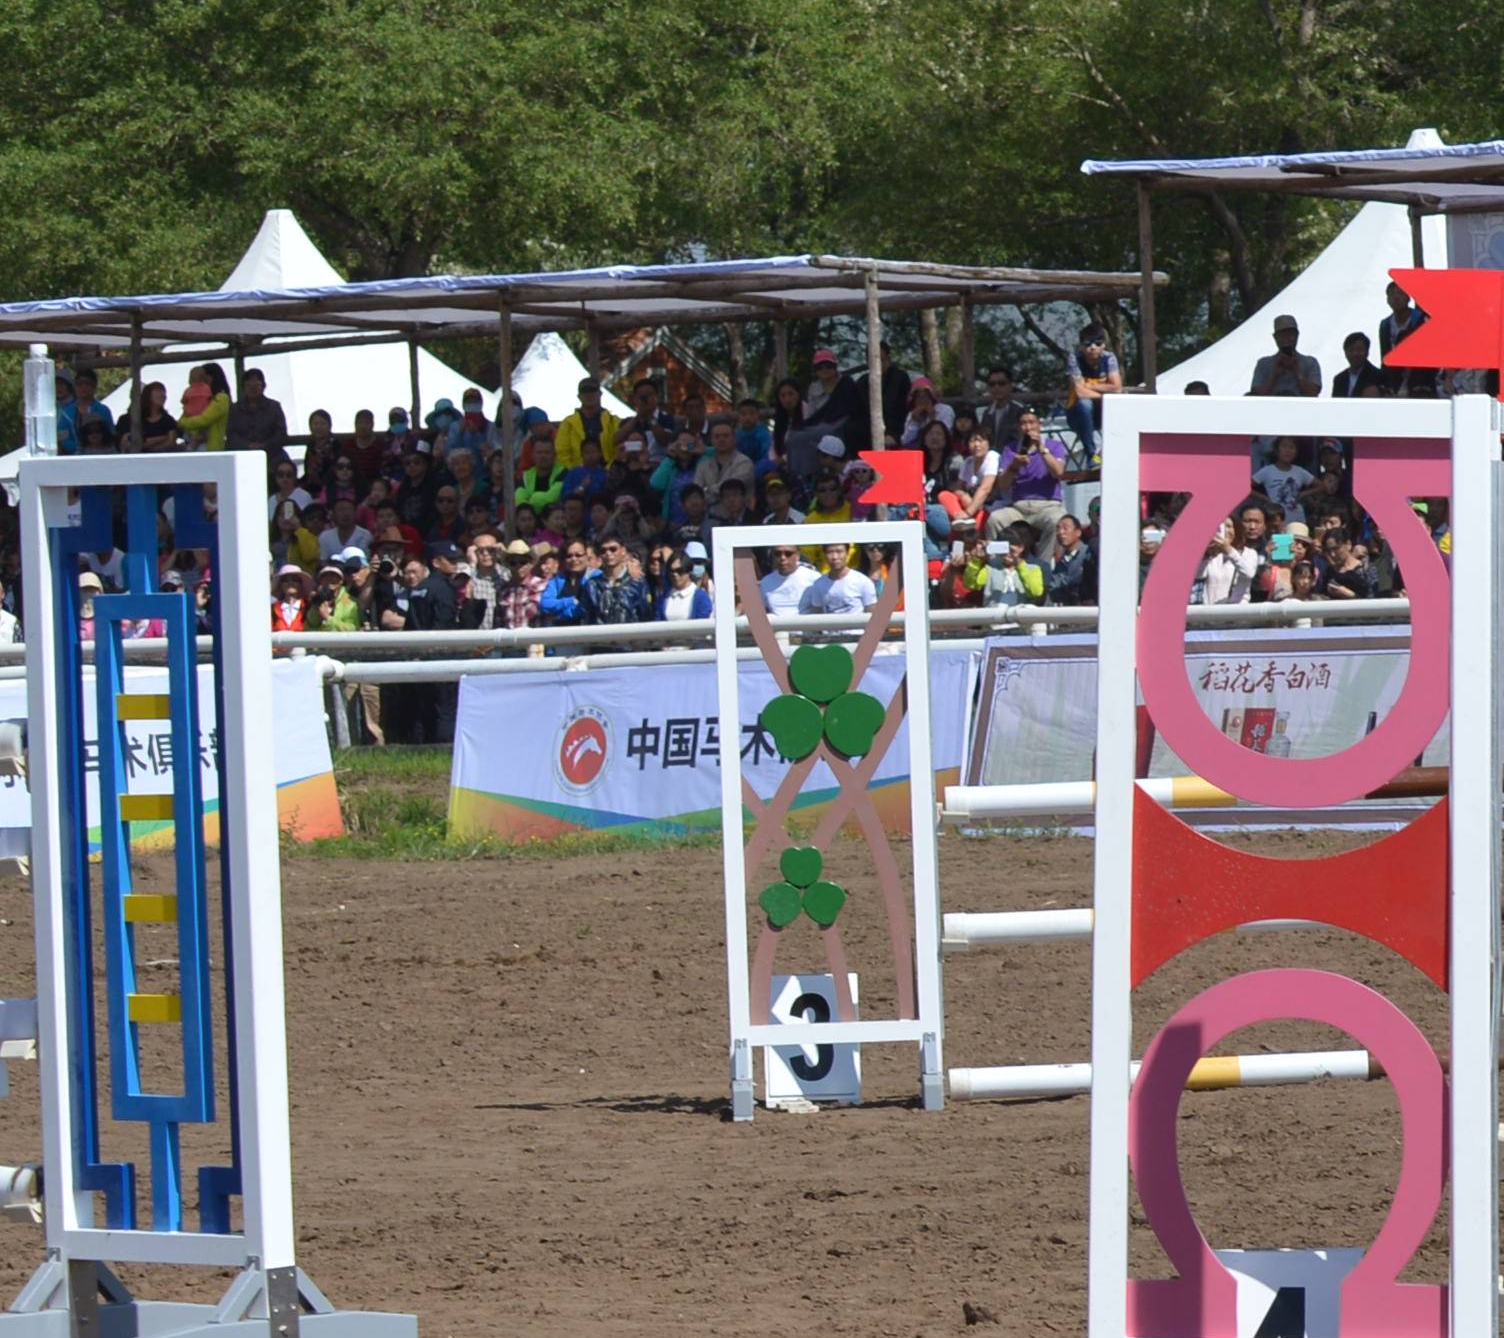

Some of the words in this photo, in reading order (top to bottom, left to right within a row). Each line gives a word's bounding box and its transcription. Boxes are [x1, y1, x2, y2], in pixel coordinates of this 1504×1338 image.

[1198, 661, 1332, 693] 稻花香白酒
[789, 992, 835, 1082] 3
